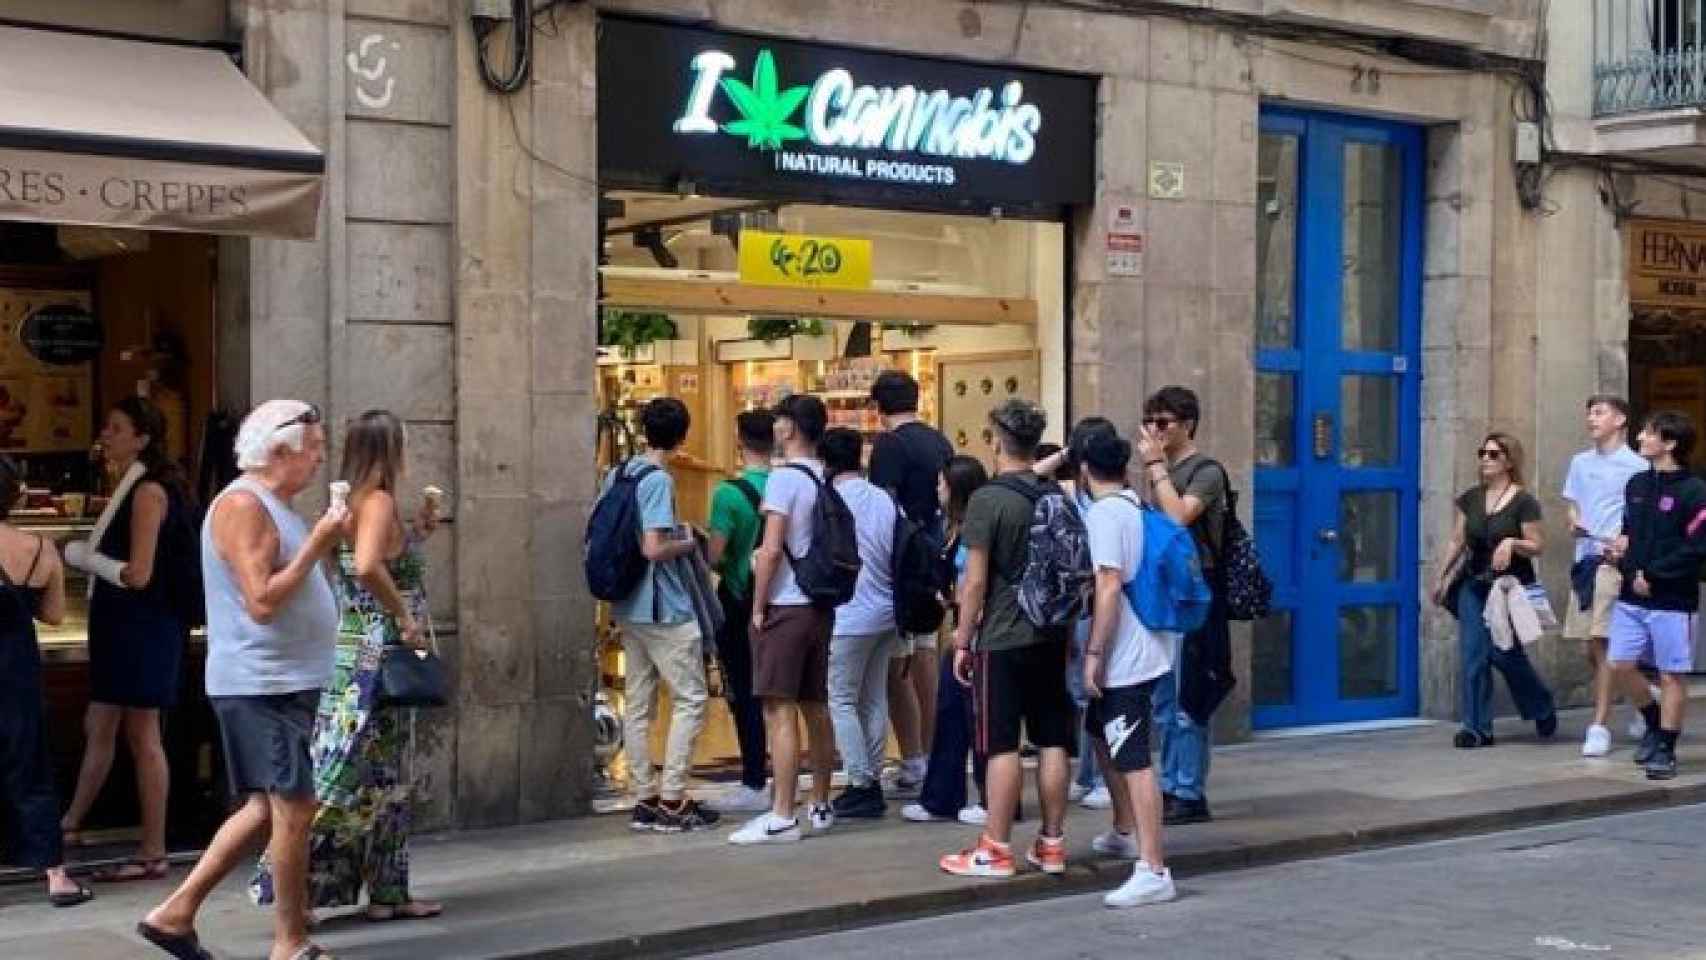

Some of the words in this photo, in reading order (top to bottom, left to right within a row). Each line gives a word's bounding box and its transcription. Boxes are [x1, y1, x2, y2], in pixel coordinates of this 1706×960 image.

[673, 50, 736, 133] I
[806, 68, 1041, 163] Cannabis
[782, 152, 864, 176] NATURAL
[866, 159, 956, 185] PRODUCTS
[101, 176, 247, 213] CREPES
[769, 238, 842, 275] 4:20
